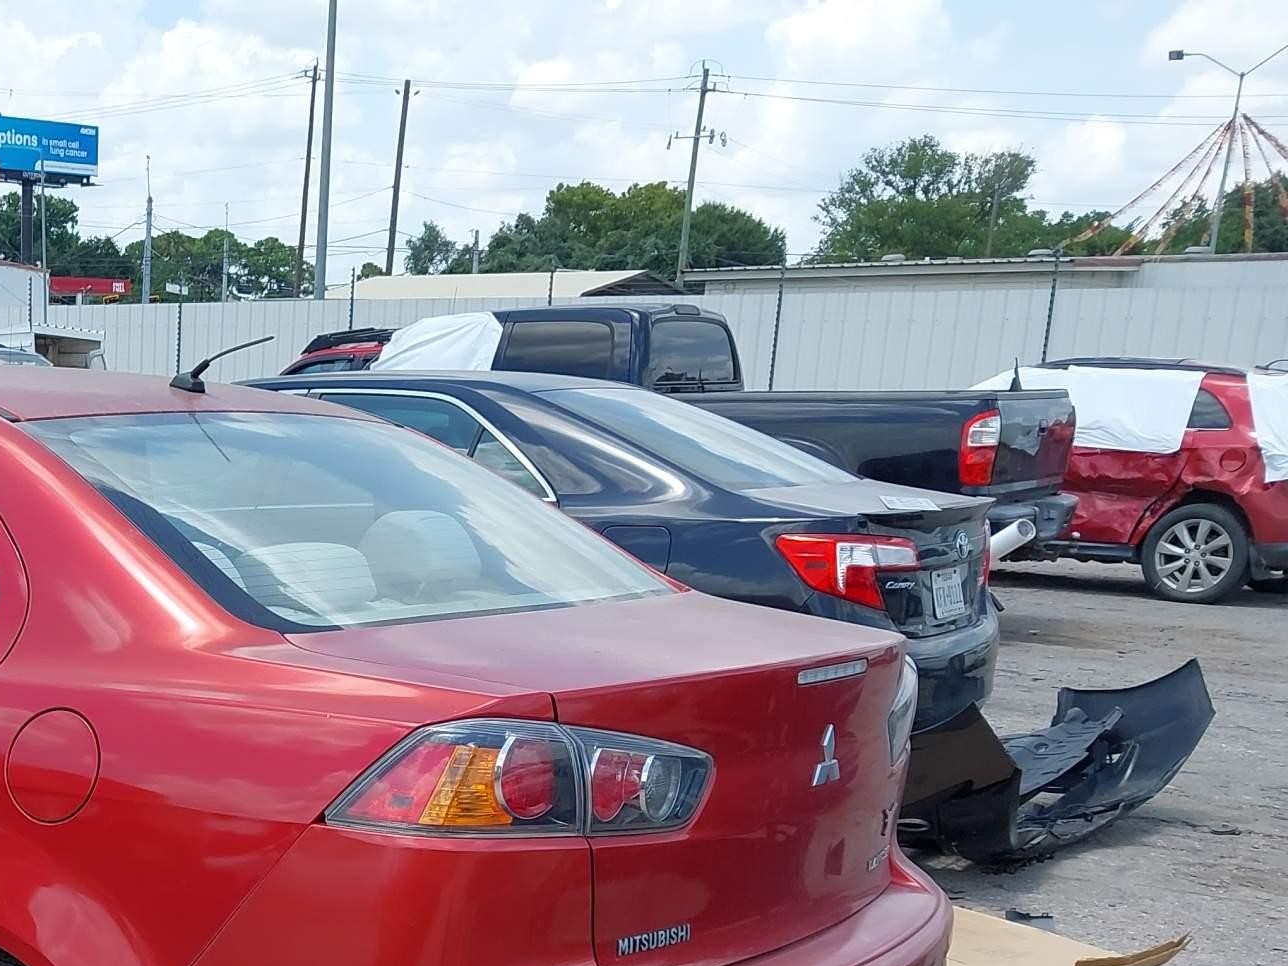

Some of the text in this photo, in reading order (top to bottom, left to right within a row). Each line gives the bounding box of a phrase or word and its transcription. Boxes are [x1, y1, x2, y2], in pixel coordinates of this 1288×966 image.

[49, 138, 67, 147] small
[67, 140, 80, 148] cell
[49, 146, 88, 158] lung cancer
[617, 923, 691, 957] MITSUBISHI
